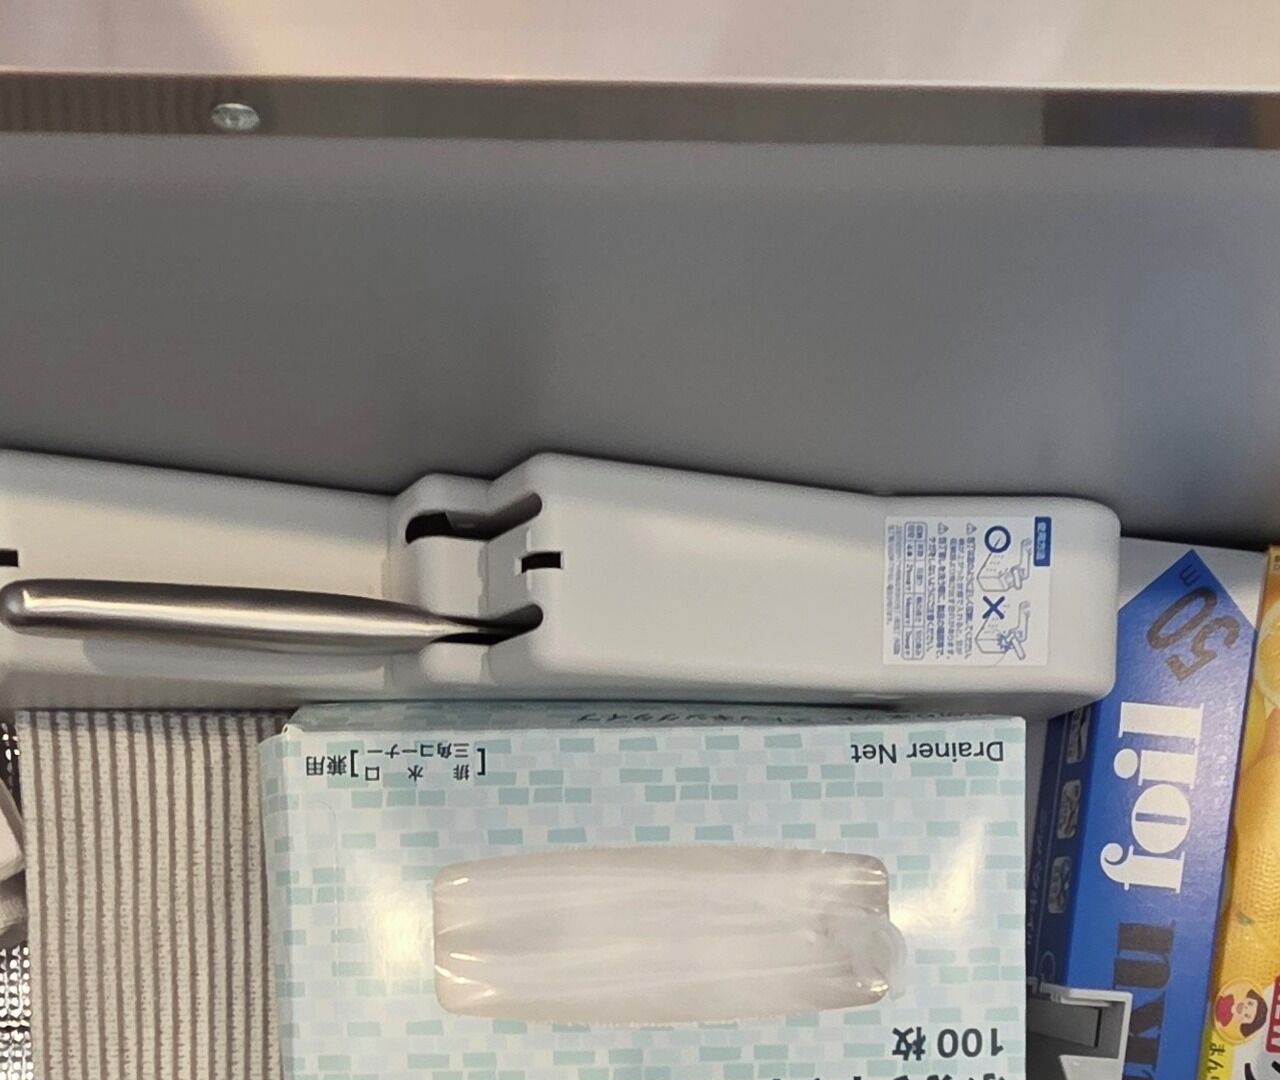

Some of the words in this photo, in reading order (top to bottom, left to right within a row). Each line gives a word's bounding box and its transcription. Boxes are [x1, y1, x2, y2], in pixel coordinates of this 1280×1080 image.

[367, 741, 470, 760] 三角コーナー
[852, 741, 898, 763] Net
[907, 740, 1005, 763] Drainer
[1101, 702, 1204, 893] foil
